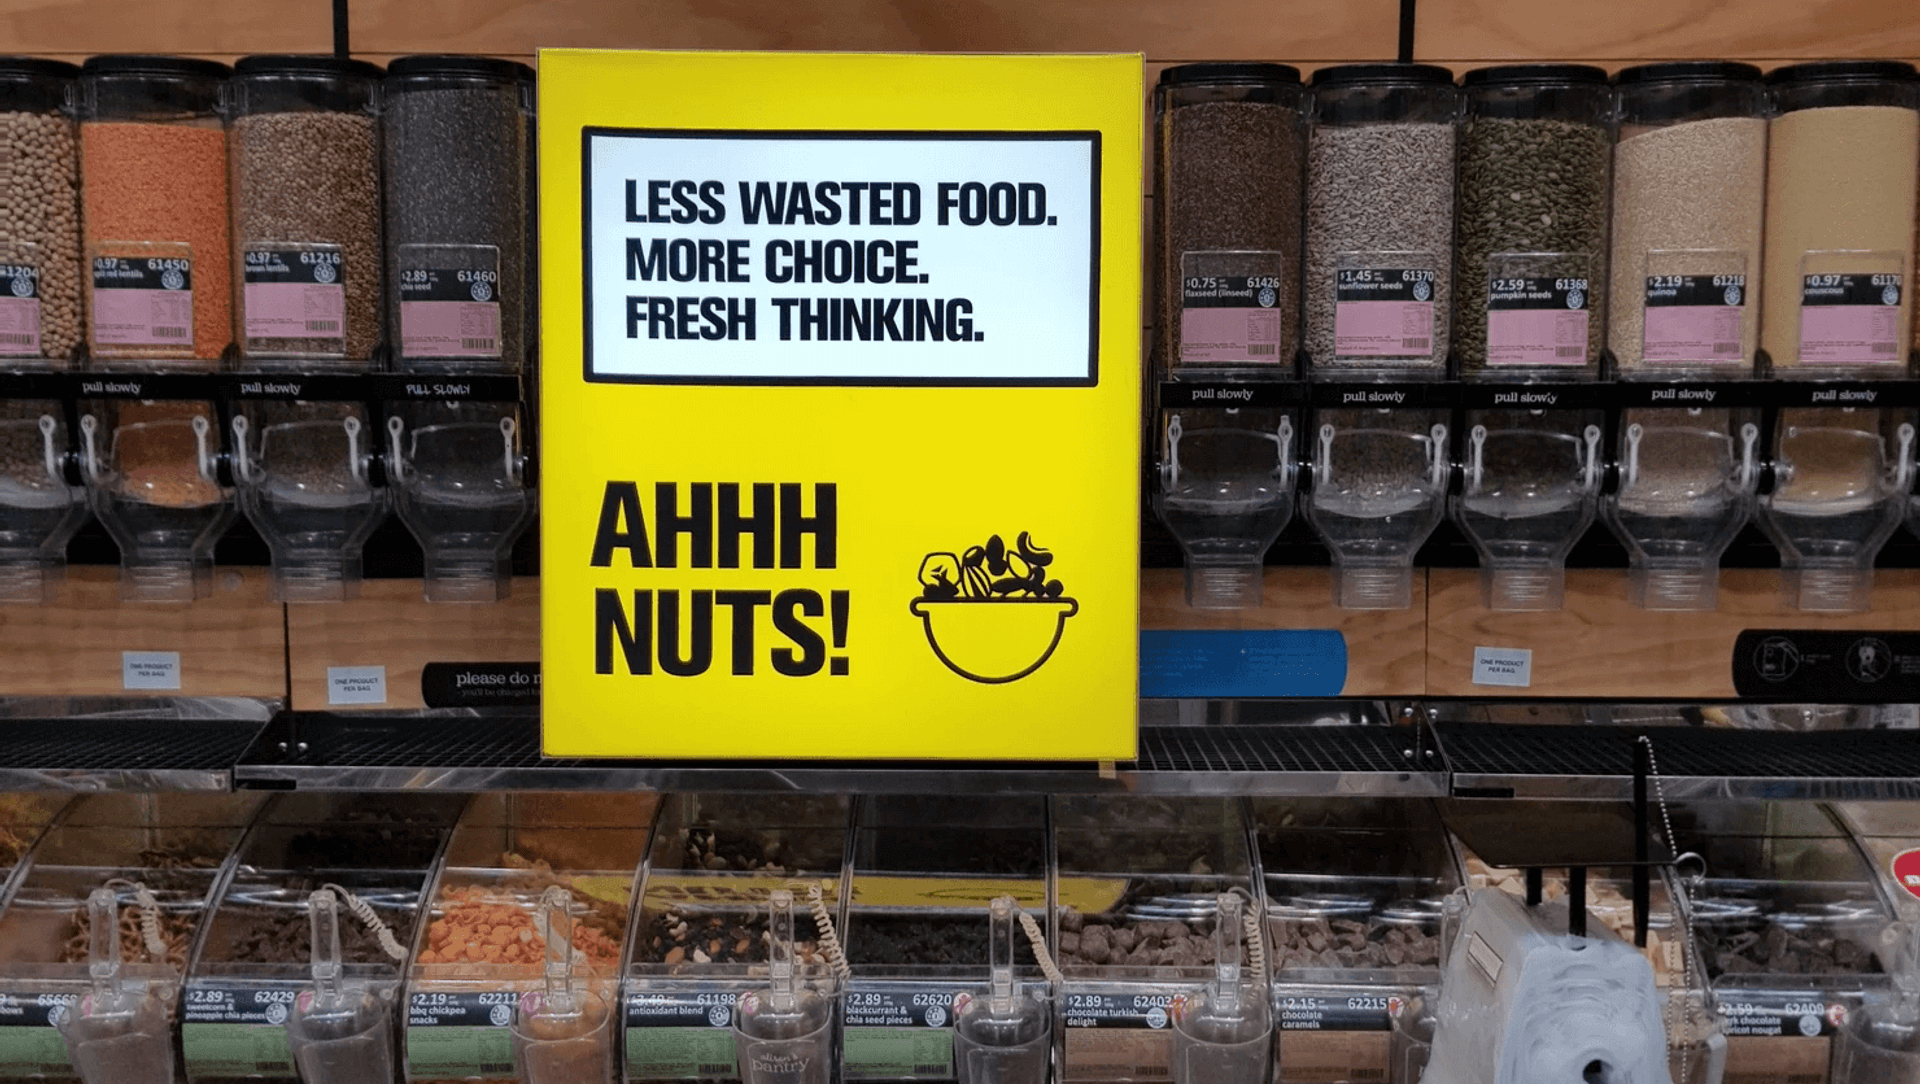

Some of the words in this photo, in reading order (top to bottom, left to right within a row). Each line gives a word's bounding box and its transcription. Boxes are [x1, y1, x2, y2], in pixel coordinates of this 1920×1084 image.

[625, 179, 726, 224] LESS
[739, 180, 921, 226] WASTED
[937, 181, 1058, 226] FOOD.
[300, 251, 341, 264] 61216
[625, 238, 751, 283] MORE
[765, 239, 929, 284] CHOICE.
[148, 258, 190, 271] 61450
[457, 270, 497, 282] 61460
[1340, 270, 1371, 281] $1.45
[1402, 269, 1434, 281] 61370
[1713, 275, 1745, 286] 61218
[1806, 275, 1841, 286] $0.97
[401, 282, 415, 291] chia
[415, 282, 432, 291] seed
[1186, 277, 1217, 289] $0.75
[1247, 277, 1280, 289] 61426
[1338, 281, 1379, 290] sunflower
[1380, 281, 1403, 290] seeds
[1492, 279, 1525, 291] $2.59
[1555, 278, 1588, 290] 61368
[1185, 289, 1217, 298] flaxseed
[1218, 289, 1253, 299] (linseed)
[1490, 291, 1527, 301] pumpkin
[1528, 291, 1552, 299] seeds
[1647, 288, 1677, 297] quinoa
[1804, 287, 1844, 295] couscous
[626, 296, 757, 341] FRESH
[771, 297, 985, 343] THINKING.
[82, 381, 103, 394] pull
[105, 381, 142, 395] slowly
[241, 382, 262, 395] pull
[264, 383, 301, 396] slowly
[406, 384, 431, 395] PULL
[433, 384, 471, 395] SLOWLY
[1192, 388, 1215, 401] pull
[1217, 388, 1254, 401] slowly
[1343, 391, 1366, 403] pull
[1368, 391, 1406, 404] slowly
[1494, 392, 1518, 404] pull
[1520, 392, 1558, 405] slowly
[1651, 388, 1676, 401] pull
[1678, 388, 1717, 402] slowly
[1812, 389, 1837, 402] pull
[1839, 389, 1878, 402] slowly
[590, 480, 837, 569] AHHH
[594, 587, 850, 677] NUTS!
[456, 671, 506, 687] please
[509, 672, 530, 684] do
[189, 991, 223, 1003] $2.89
[254, 991, 295, 1003] 62429
[412, 993, 447, 1005] $2.19
[478, 993, 518, 1005] 62211
[697, 993, 736, 1005] 61198
[848, 993, 881, 1005] $2.89
[913, 993, 952, 1005] 62620
[1069, 995, 1101, 1007] $2.89
[629, 1006, 677, 1014] antioxidant
[679, 1006, 703, 1014] blend
[846, 1006, 898, 1014] blackcurrant
[900, 1006, 908, 1014] &
[1282, 998, 1316, 1010] $2.15
[1348, 998, 1387, 1010] 62215
[186, 1012, 223, 1020] pineapple
[225, 1011, 241, 1019] chia
[241, 1011, 265, 1020] pieces
[410, 1006, 427, 1015] bbq
[428, 1006, 466, 1015] chickpea
[1067, 1008, 1107, 1016] chocolate
[1109, 1007, 1138, 1016] turkish
[1281, 1010, 1323, 1020] chocolate
[410, 1016, 438, 1024] snacks
[846, 1015, 863, 1024] chia
[865, 1015, 885, 1024] seed
[886, 1015, 913, 1025] pieces
[1067, 1017, 1097, 1027] delight
[1281, 1020, 1320, 1028] caramels
[1740, 1016, 1781, 1025] chocolate
[1751, 1026, 1782, 1035] nougat
[752, 1058, 810, 1074] pantry
